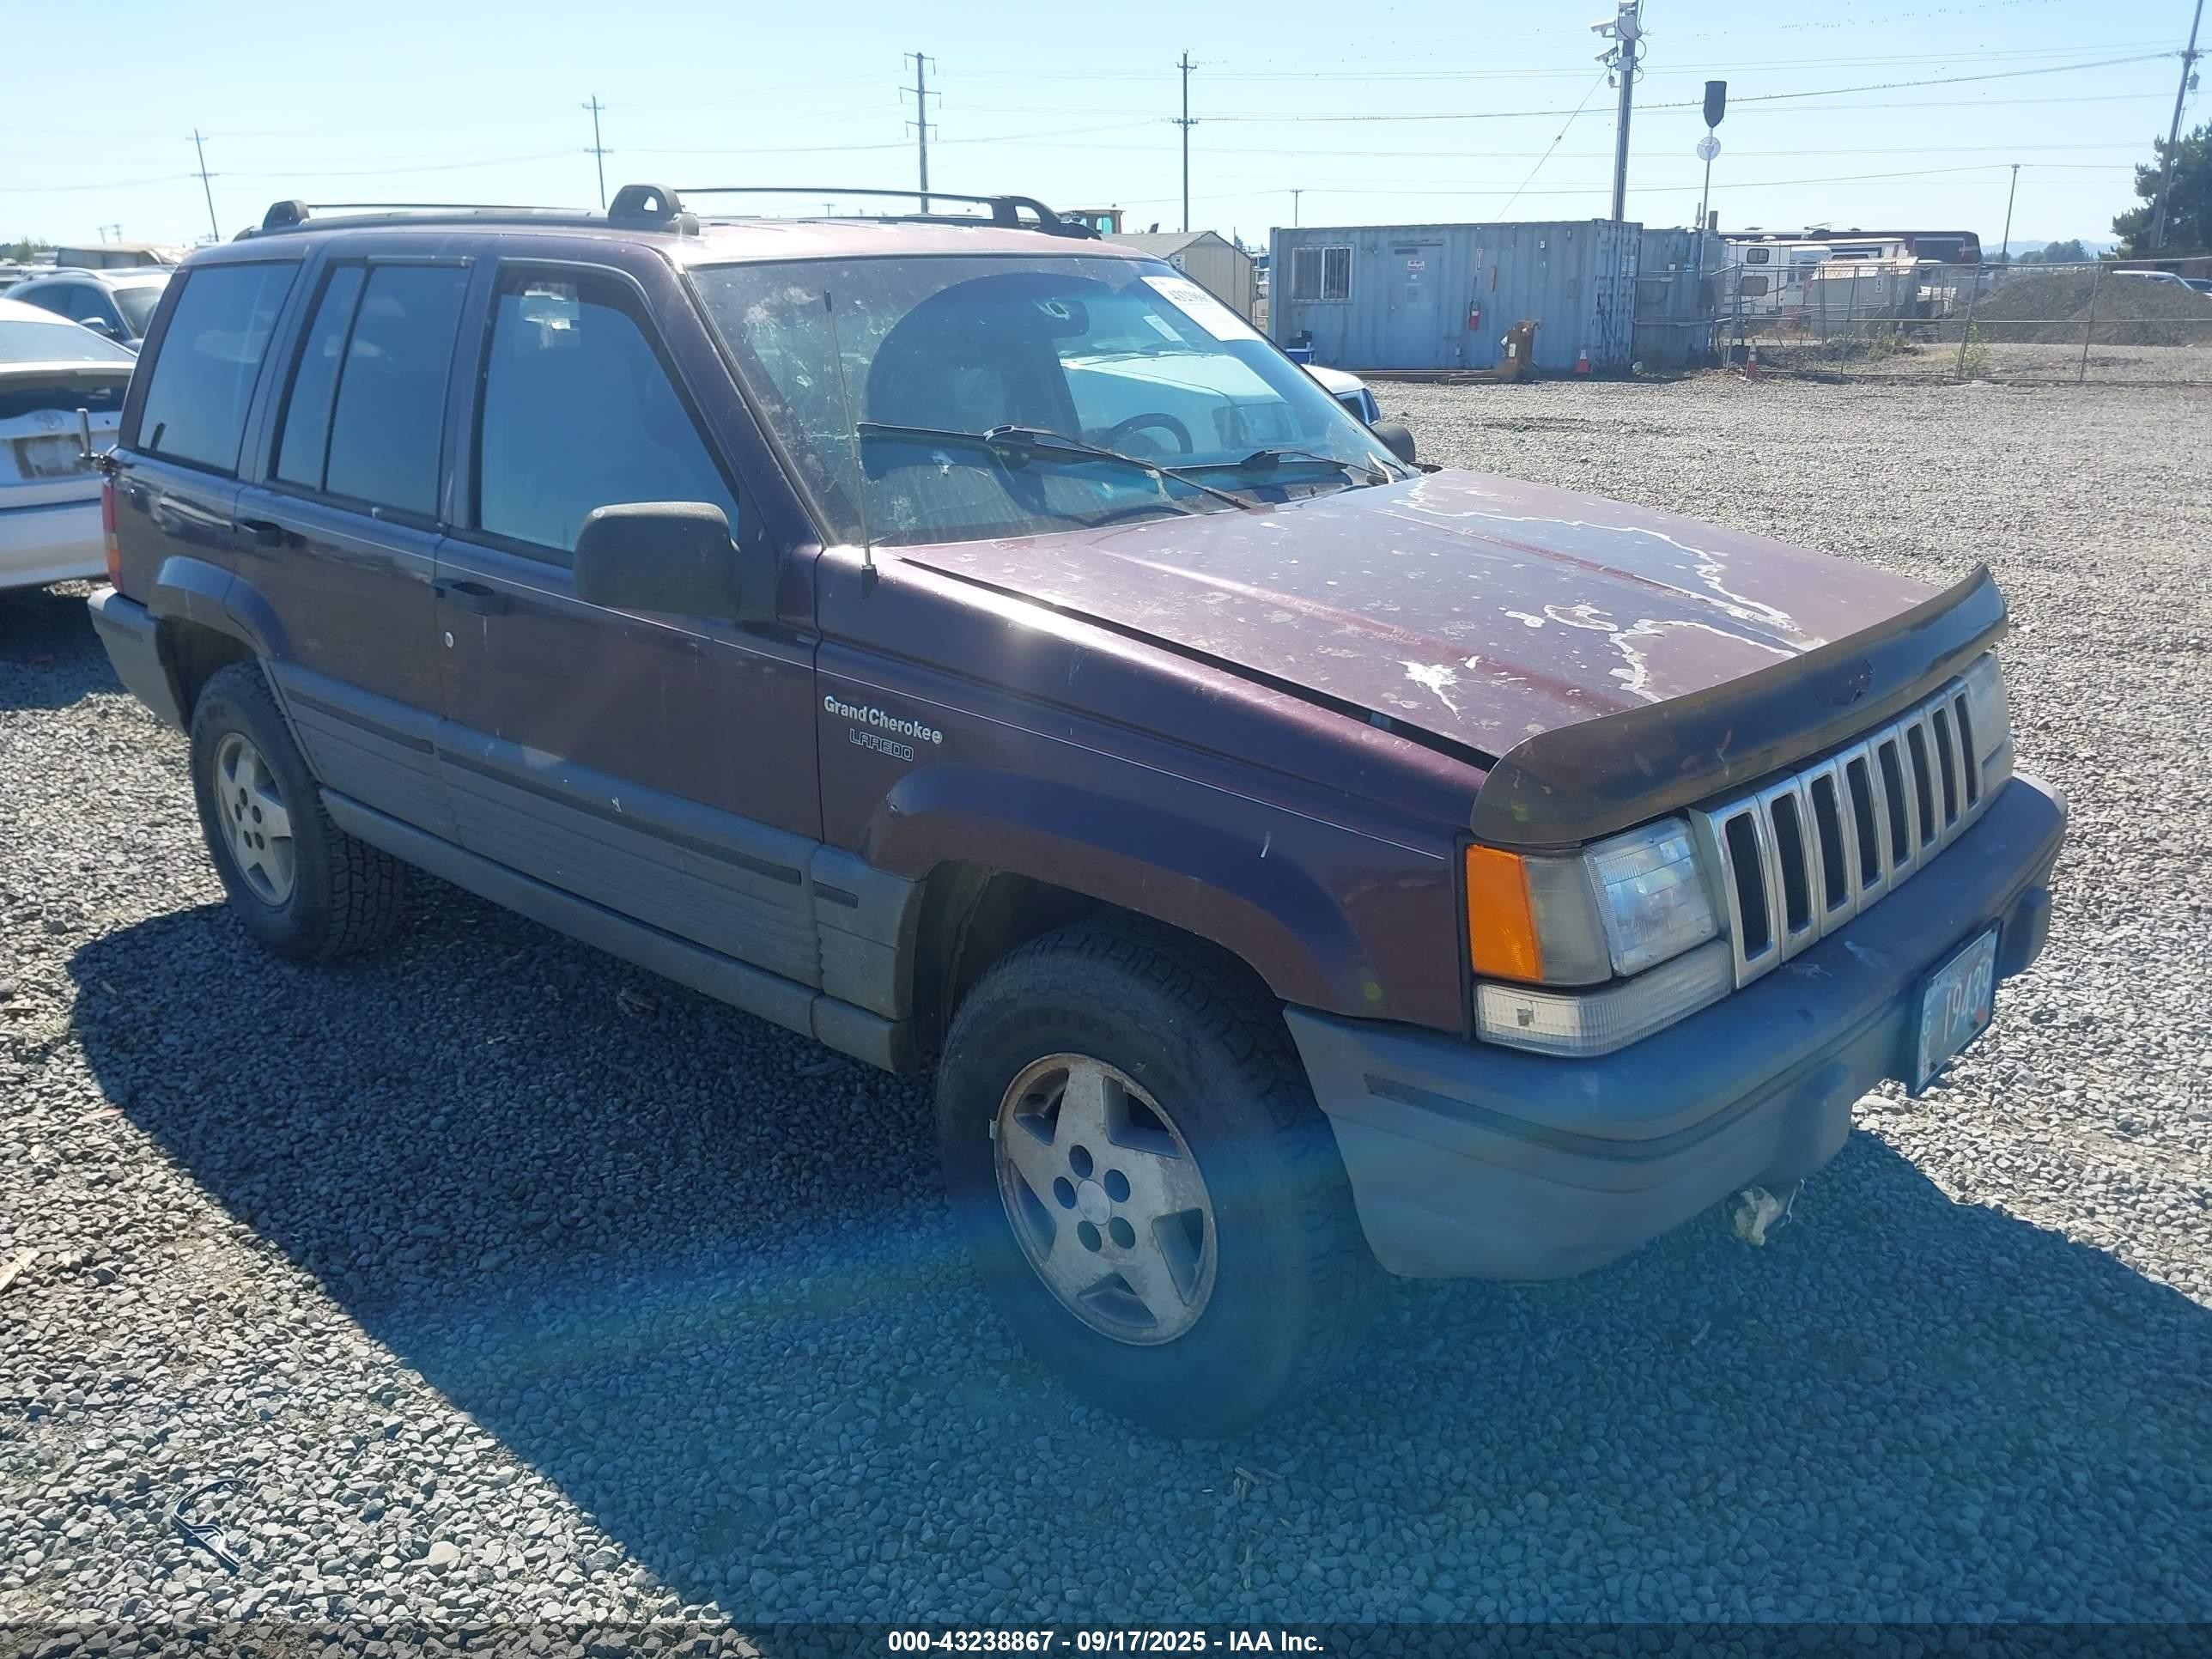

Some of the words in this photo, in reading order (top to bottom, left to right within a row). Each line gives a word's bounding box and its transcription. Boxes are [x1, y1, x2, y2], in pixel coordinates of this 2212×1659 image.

[823, 695, 867, 723] Grand
[868, 708, 944, 745] Cherokee
[849, 728, 915, 763] LAREDO
[1943, 957, 1992, 1043] 19439
